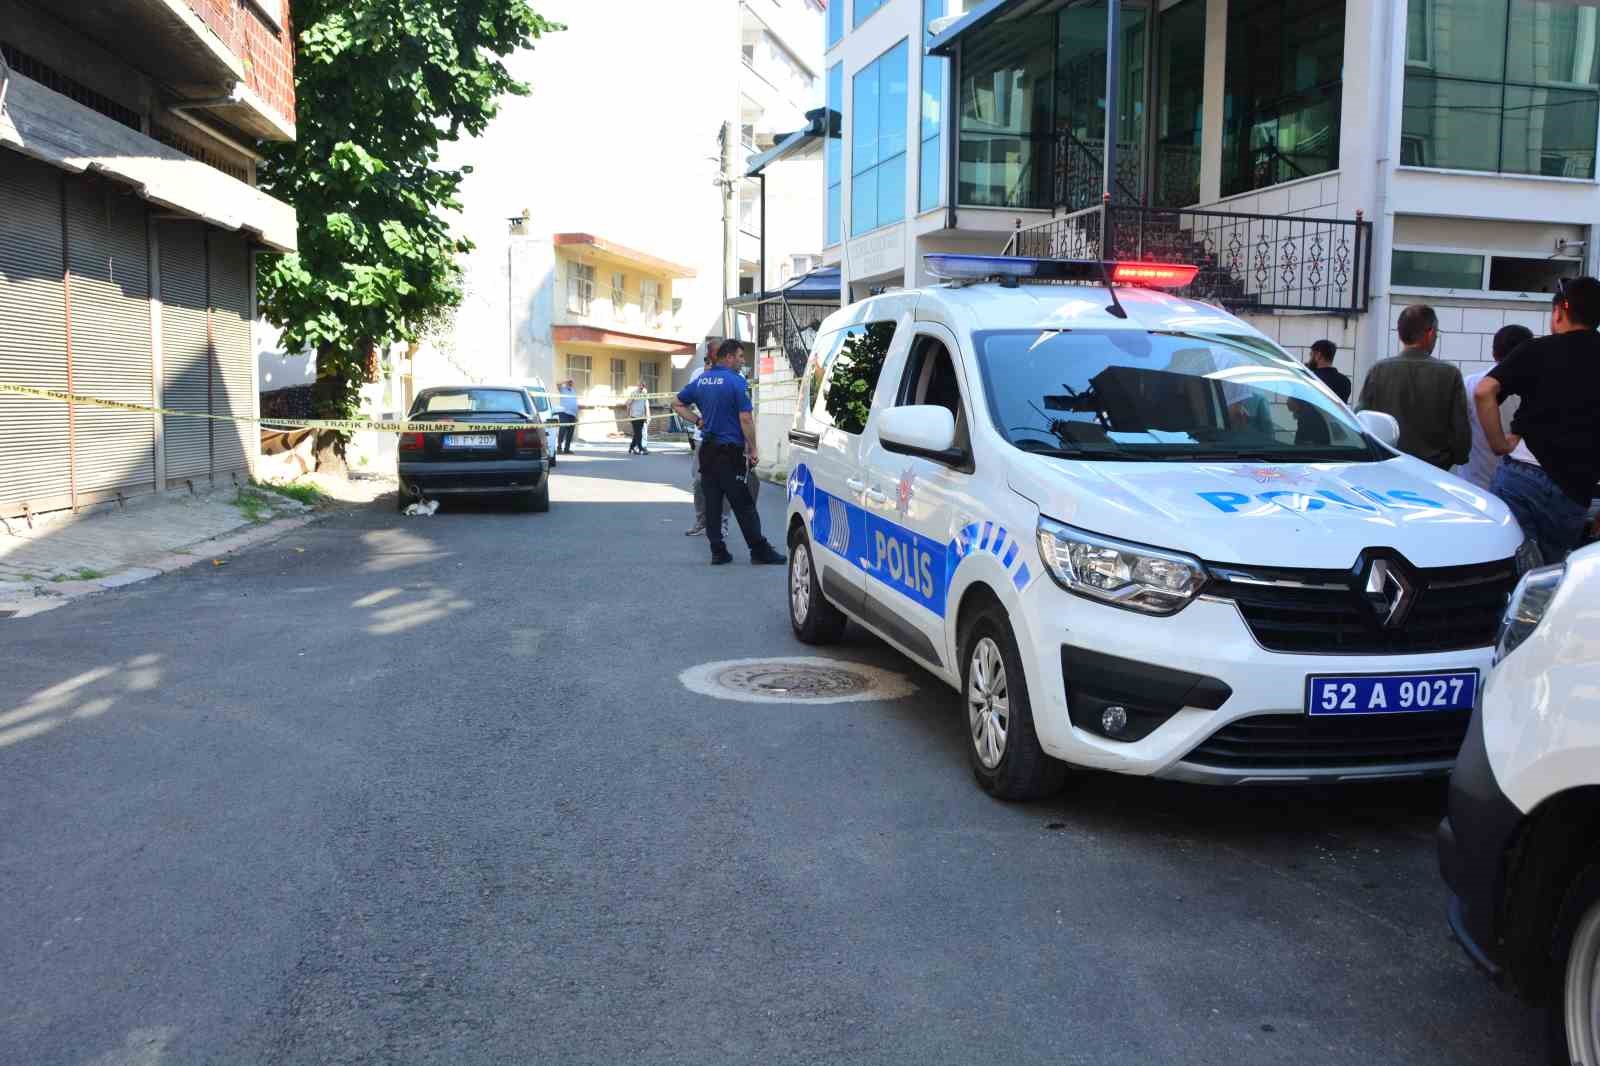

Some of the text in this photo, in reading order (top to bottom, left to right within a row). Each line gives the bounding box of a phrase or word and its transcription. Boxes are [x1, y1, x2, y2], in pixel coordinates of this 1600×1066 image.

[874, 530, 934, 600] POLİS
[1321, 678, 1464, 710] 52 A 9027
